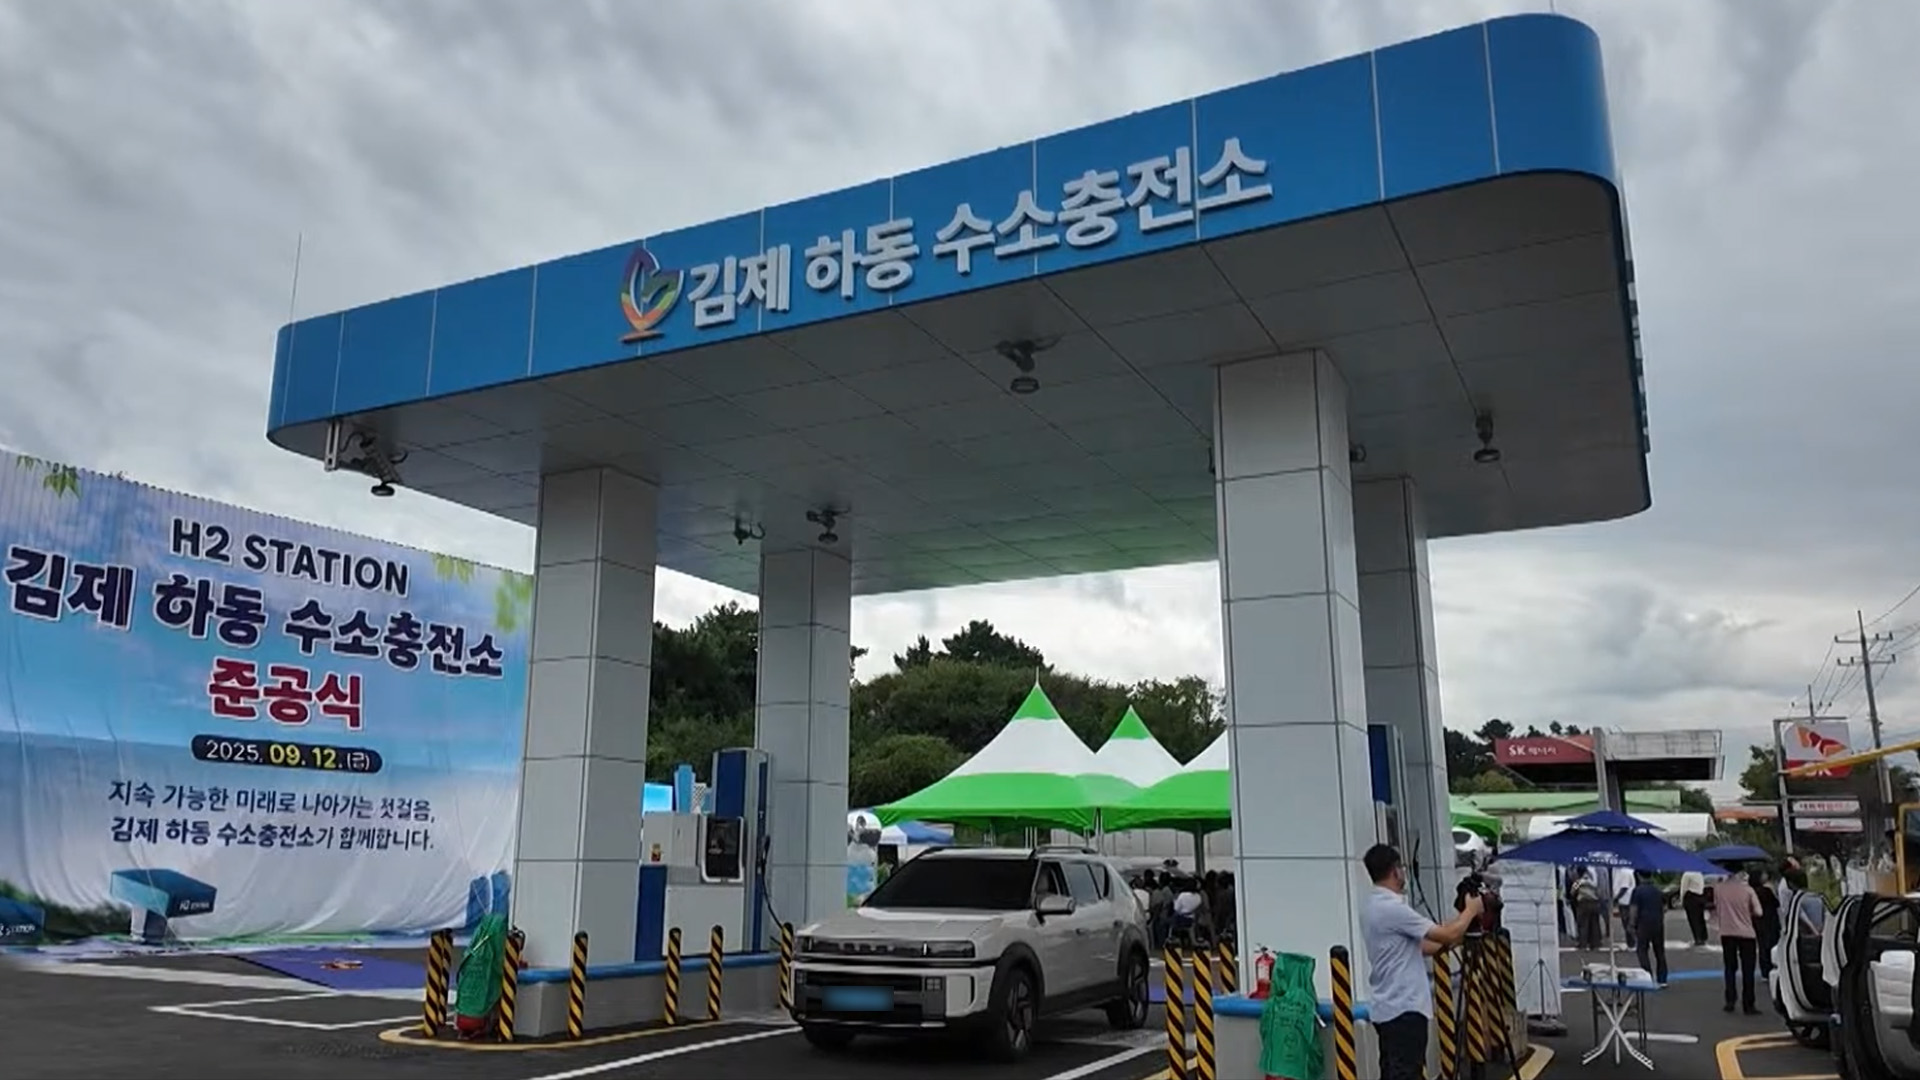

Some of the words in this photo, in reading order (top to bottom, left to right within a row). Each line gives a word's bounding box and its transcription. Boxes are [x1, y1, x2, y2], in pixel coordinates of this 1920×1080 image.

[687, 243, 791, 327] 김제
[805, 217, 919, 299] 하동
[933, 137, 1273, 274] 수소충전소
[172, 518, 231, 563] H2
[243, 534, 408, 596] STATION
[4, 546, 135, 628] 김제
[155, 573, 267, 646] 하동
[285, 600, 503, 677] 수소충전소
[208, 658, 362, 729] 준공식
[205, 739, 263, 763] 2025.
[269, 743, 306, 767] 09.
[1508, 744, 1526, 756] SK
[108, 780, 156, 808] 지속
[163, 784, 229, 812] 가능한
[236, 788, 296, 814] 미래로
[302, 793, 374, 819] 나아가는
[111, 816, 159, 844] 김제
[165, 818, 211, 846] 하동
[217, 822, 334, 849] 수소충전소가
[339, 826, 434, 852] 함께합니다.
